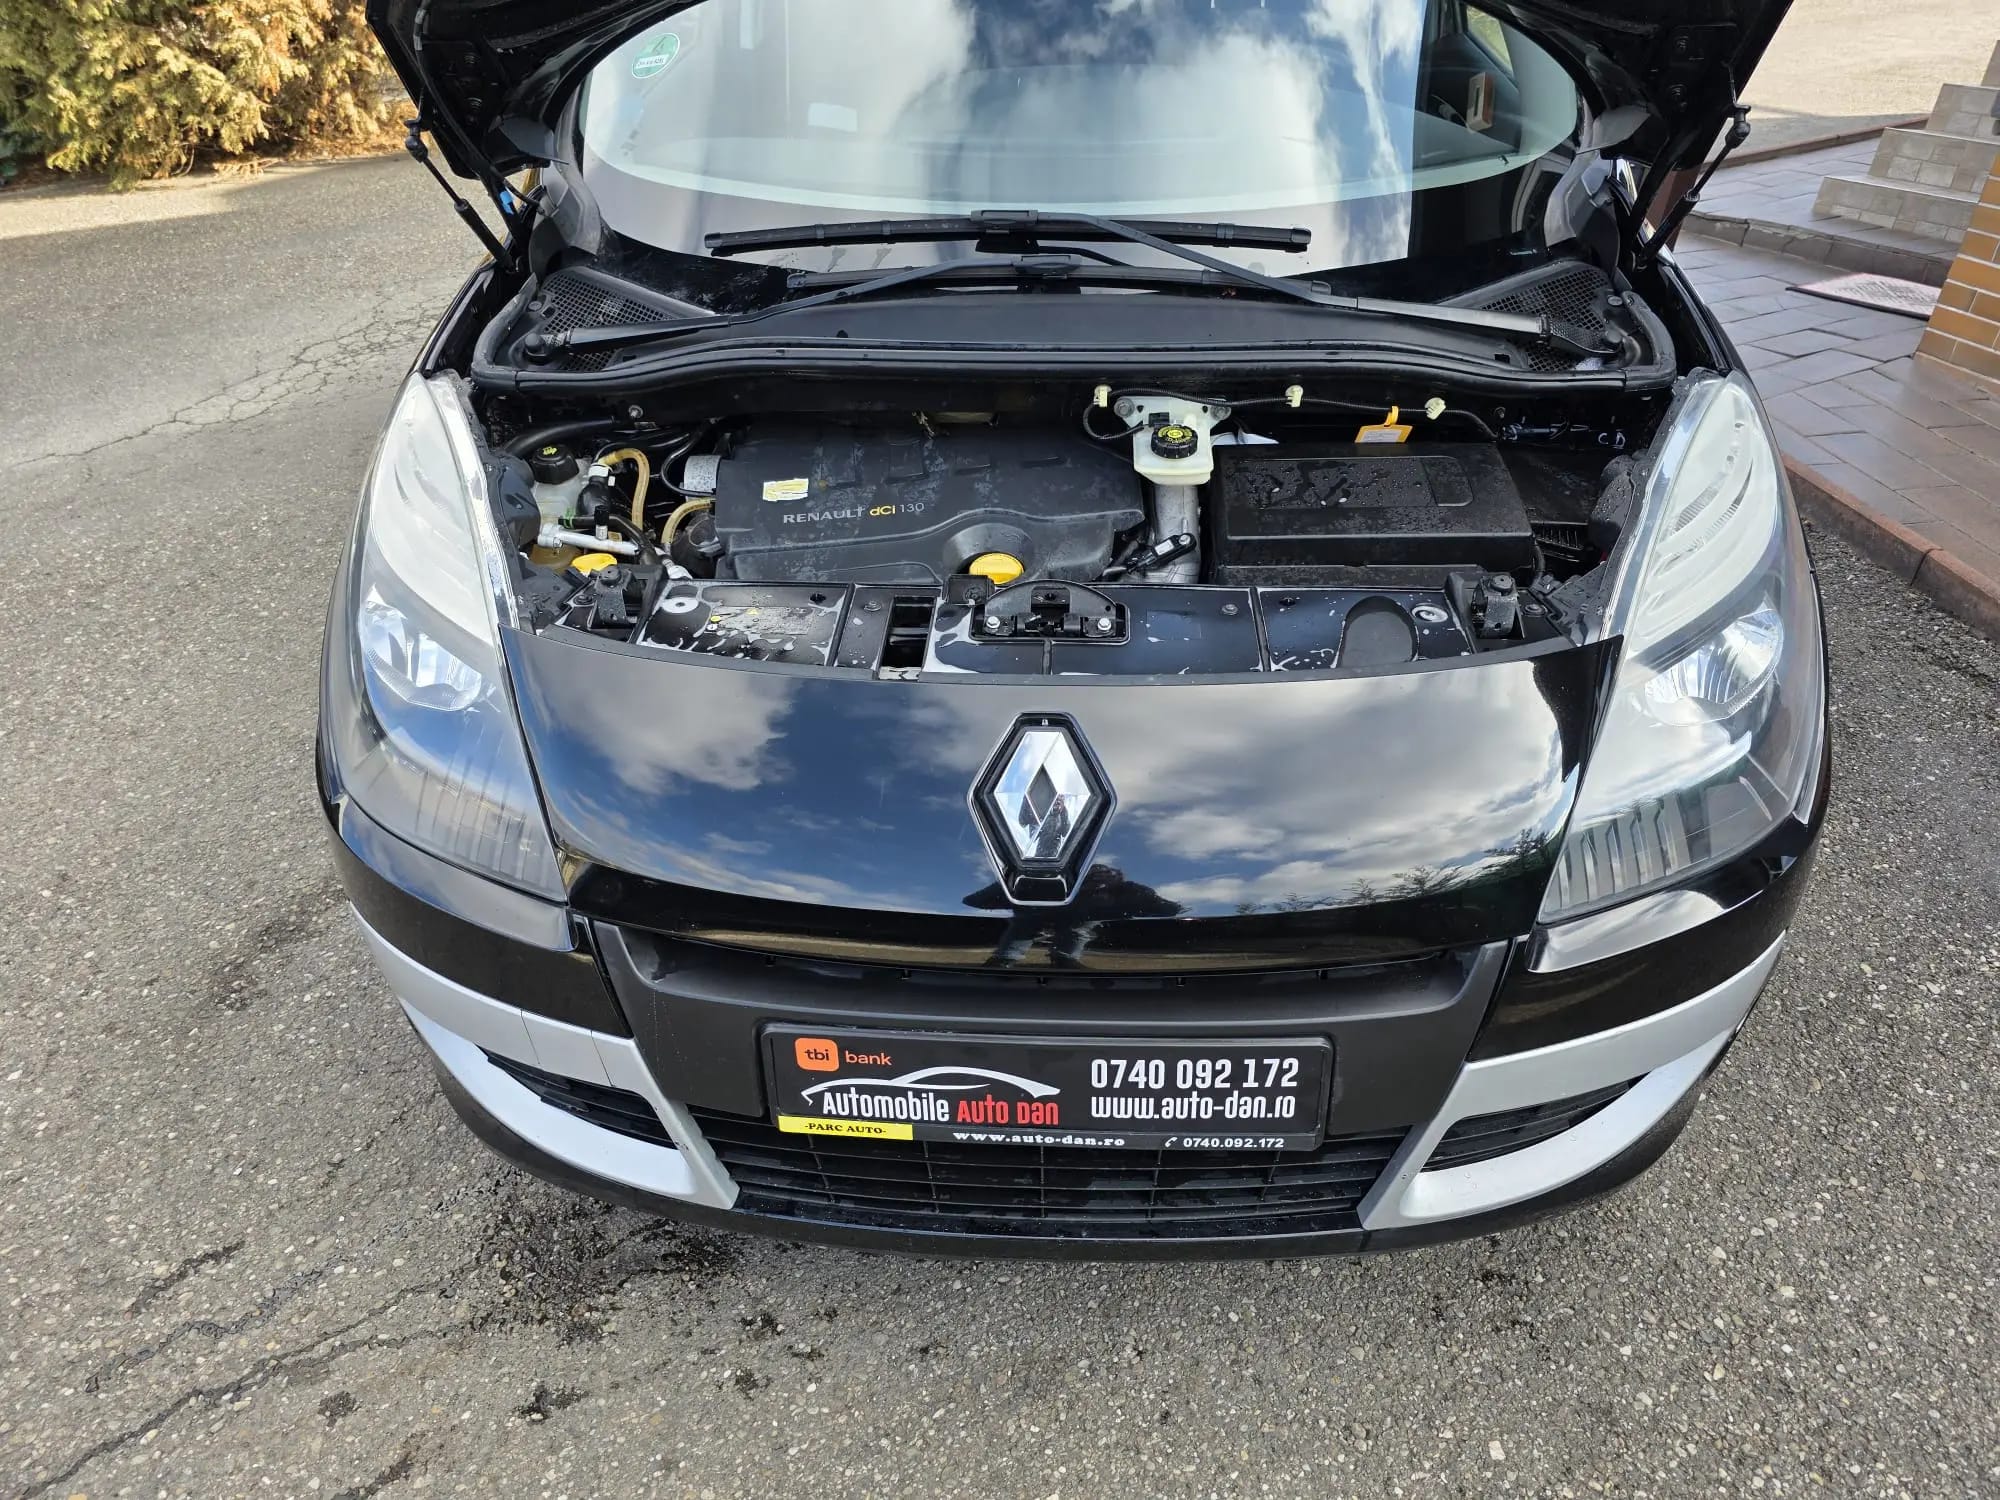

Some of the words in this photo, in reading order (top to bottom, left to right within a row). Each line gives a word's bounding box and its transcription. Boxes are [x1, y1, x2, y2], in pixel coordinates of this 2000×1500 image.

[783, 506, 866, 524] RENAULT
[900, 502, 925, 513] 130
[804, 1048, 830, 1062] tbi
[845, 1051, 892, 1066] bank
[1091, 1058, 1165, 1089] 0740
[1176, 1059, 1232, 1089] 092
[1242, 1058, 1299, 1088] 172
[823, 1087, 950, 1122] Automobile
[1091, 1090, 1296, 1119] www.auto-dan.ro
[953, 1132, 1125, 1147] www.auto-dan.ro
[1183, 1137, 1285, 1148] 0740.092.172
